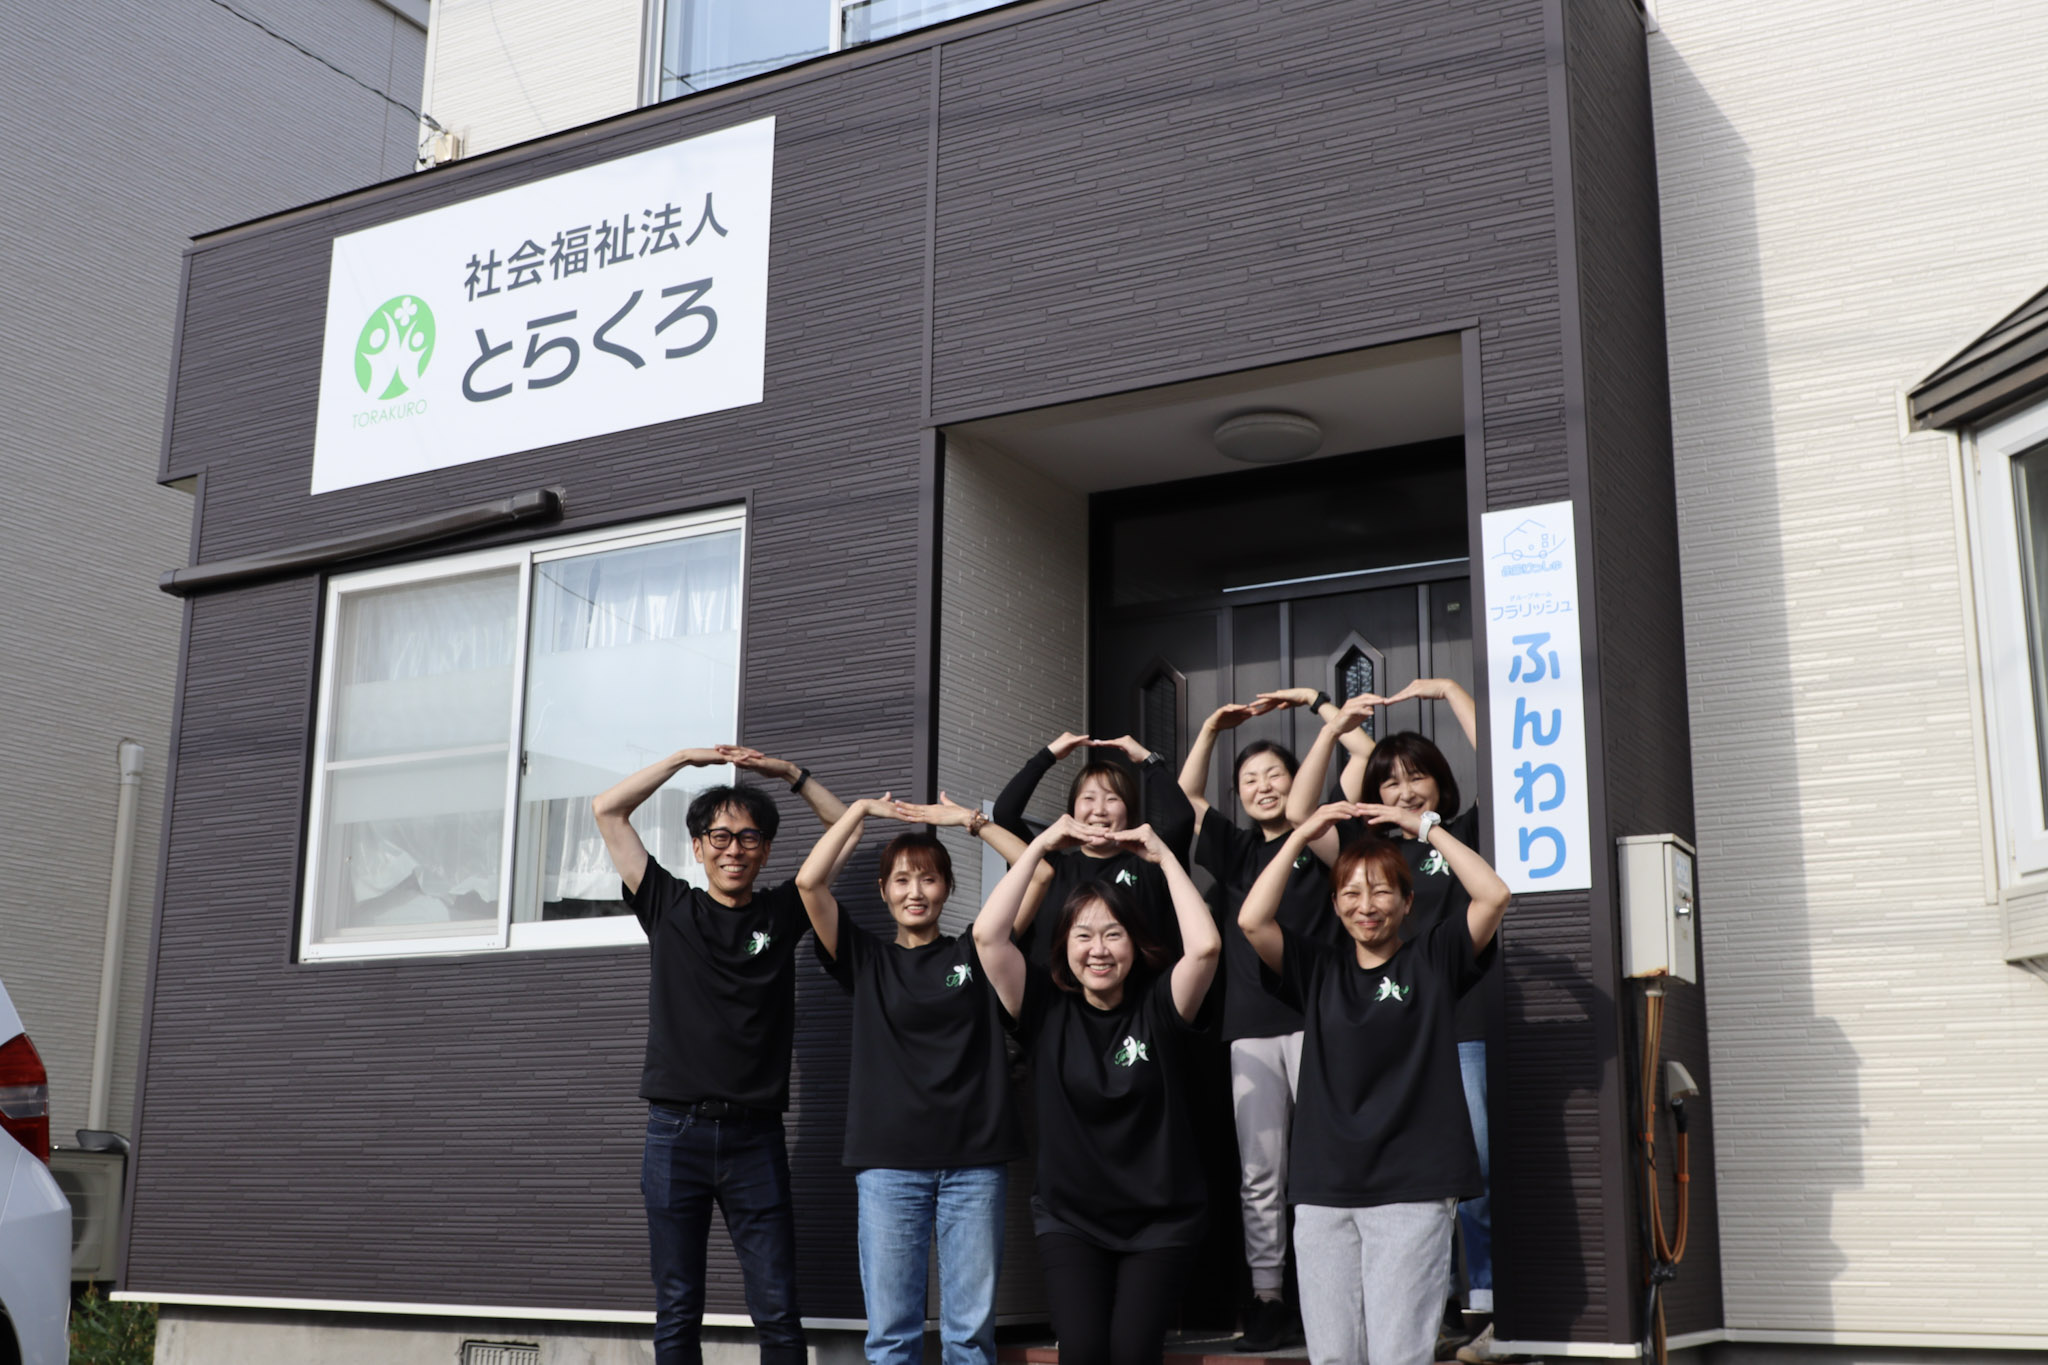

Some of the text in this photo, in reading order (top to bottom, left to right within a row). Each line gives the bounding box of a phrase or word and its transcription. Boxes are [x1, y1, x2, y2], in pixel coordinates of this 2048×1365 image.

[463, 191, 729, 302] 社会福祉法人
[461, 277, 719, 403] とらくろ
[352, 398, 428, 429] TORAKURO
[1490, 600, 1573, 621] フラリッシュ
[1508, 632, 1567, 879] ふんわり
